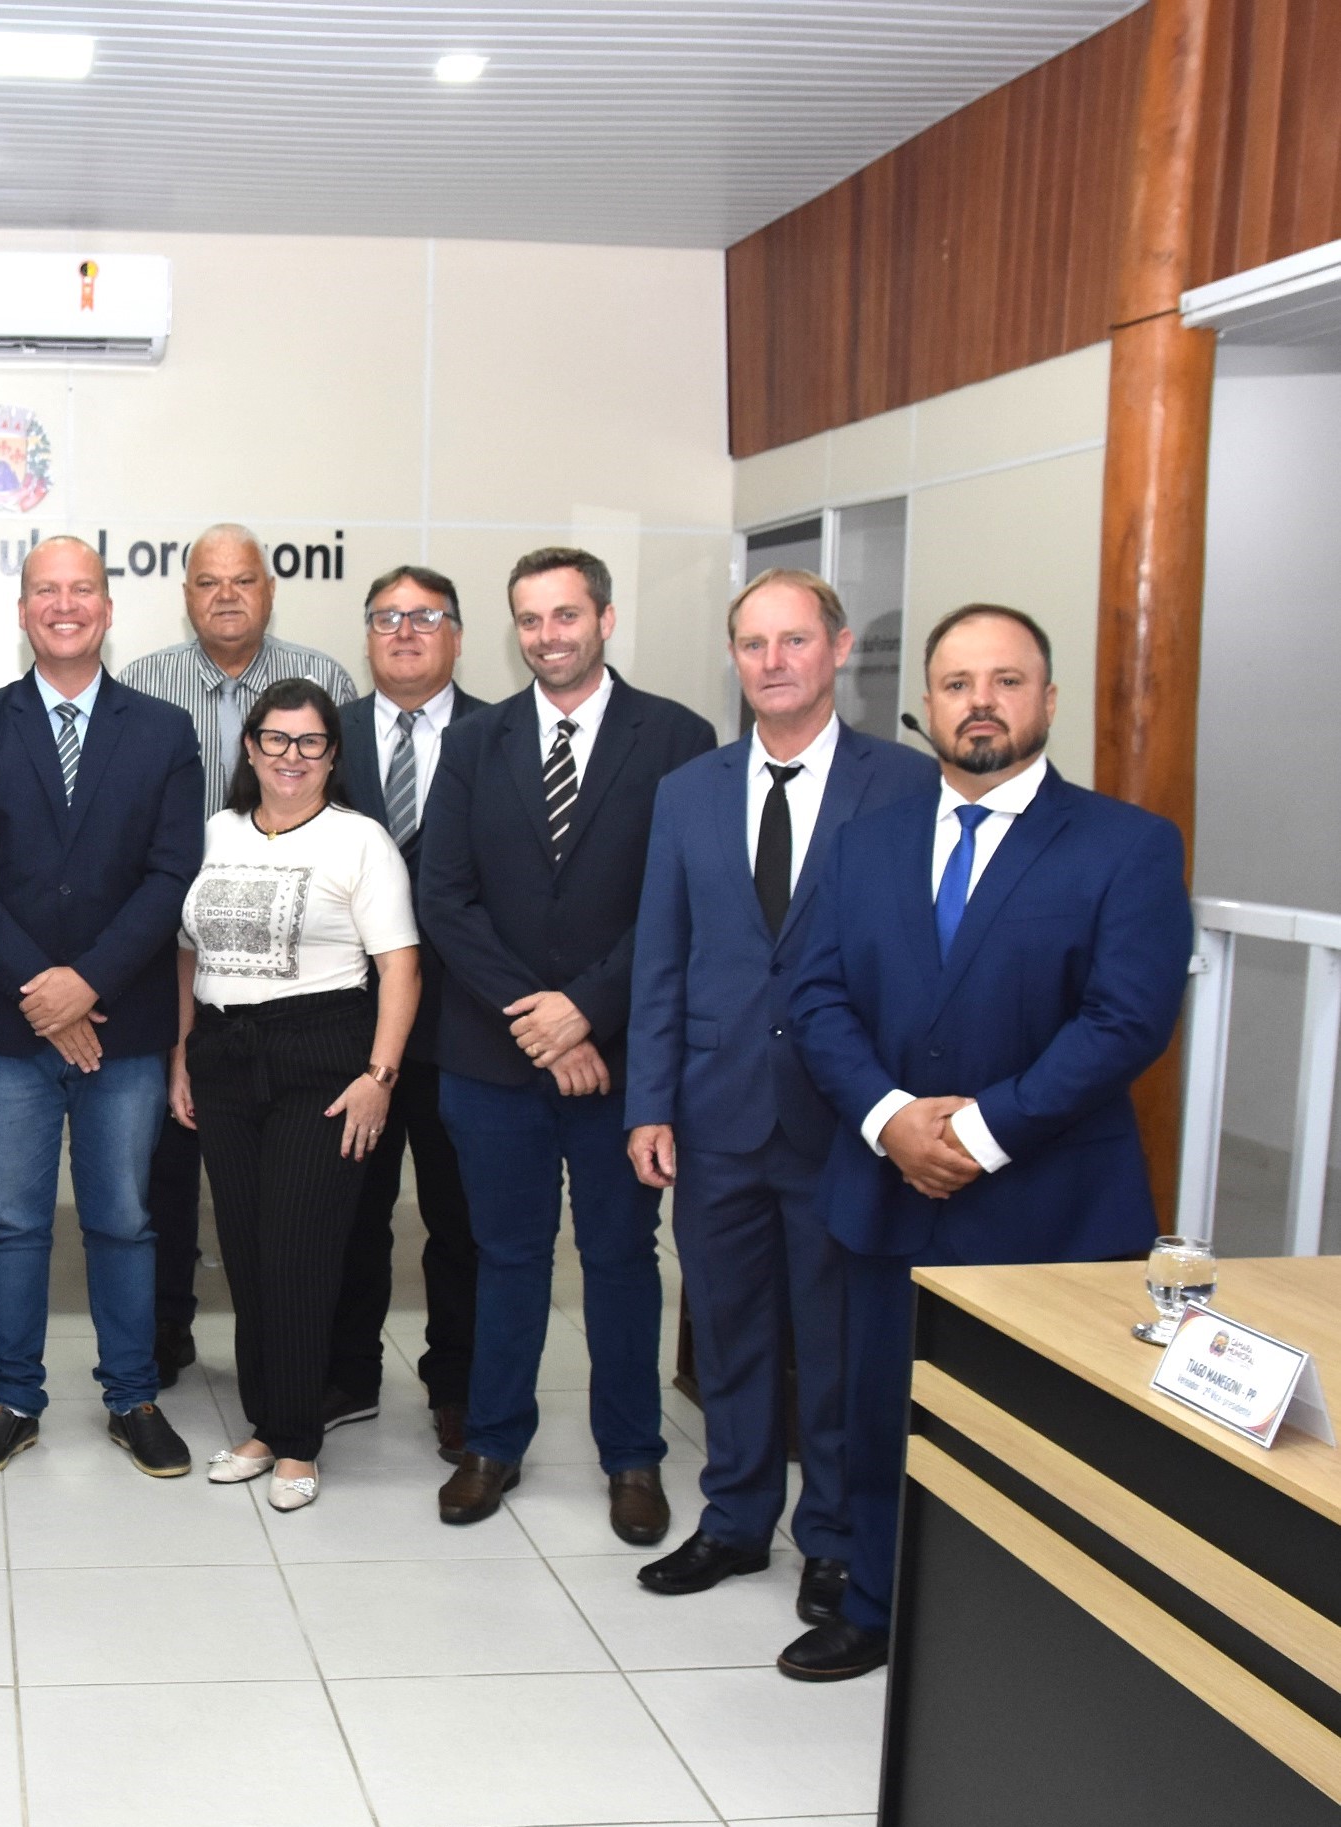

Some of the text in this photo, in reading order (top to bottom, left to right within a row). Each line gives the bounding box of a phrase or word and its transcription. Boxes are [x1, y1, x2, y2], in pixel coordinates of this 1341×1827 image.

[207, 909, 256, 918] BOHO CHIC
[1186, 1358, 1208, 1378] TIAGO
[1205, 1368, 1243, 1396] MANEGONI
[1245, 1387, 1258, 1402] PP
